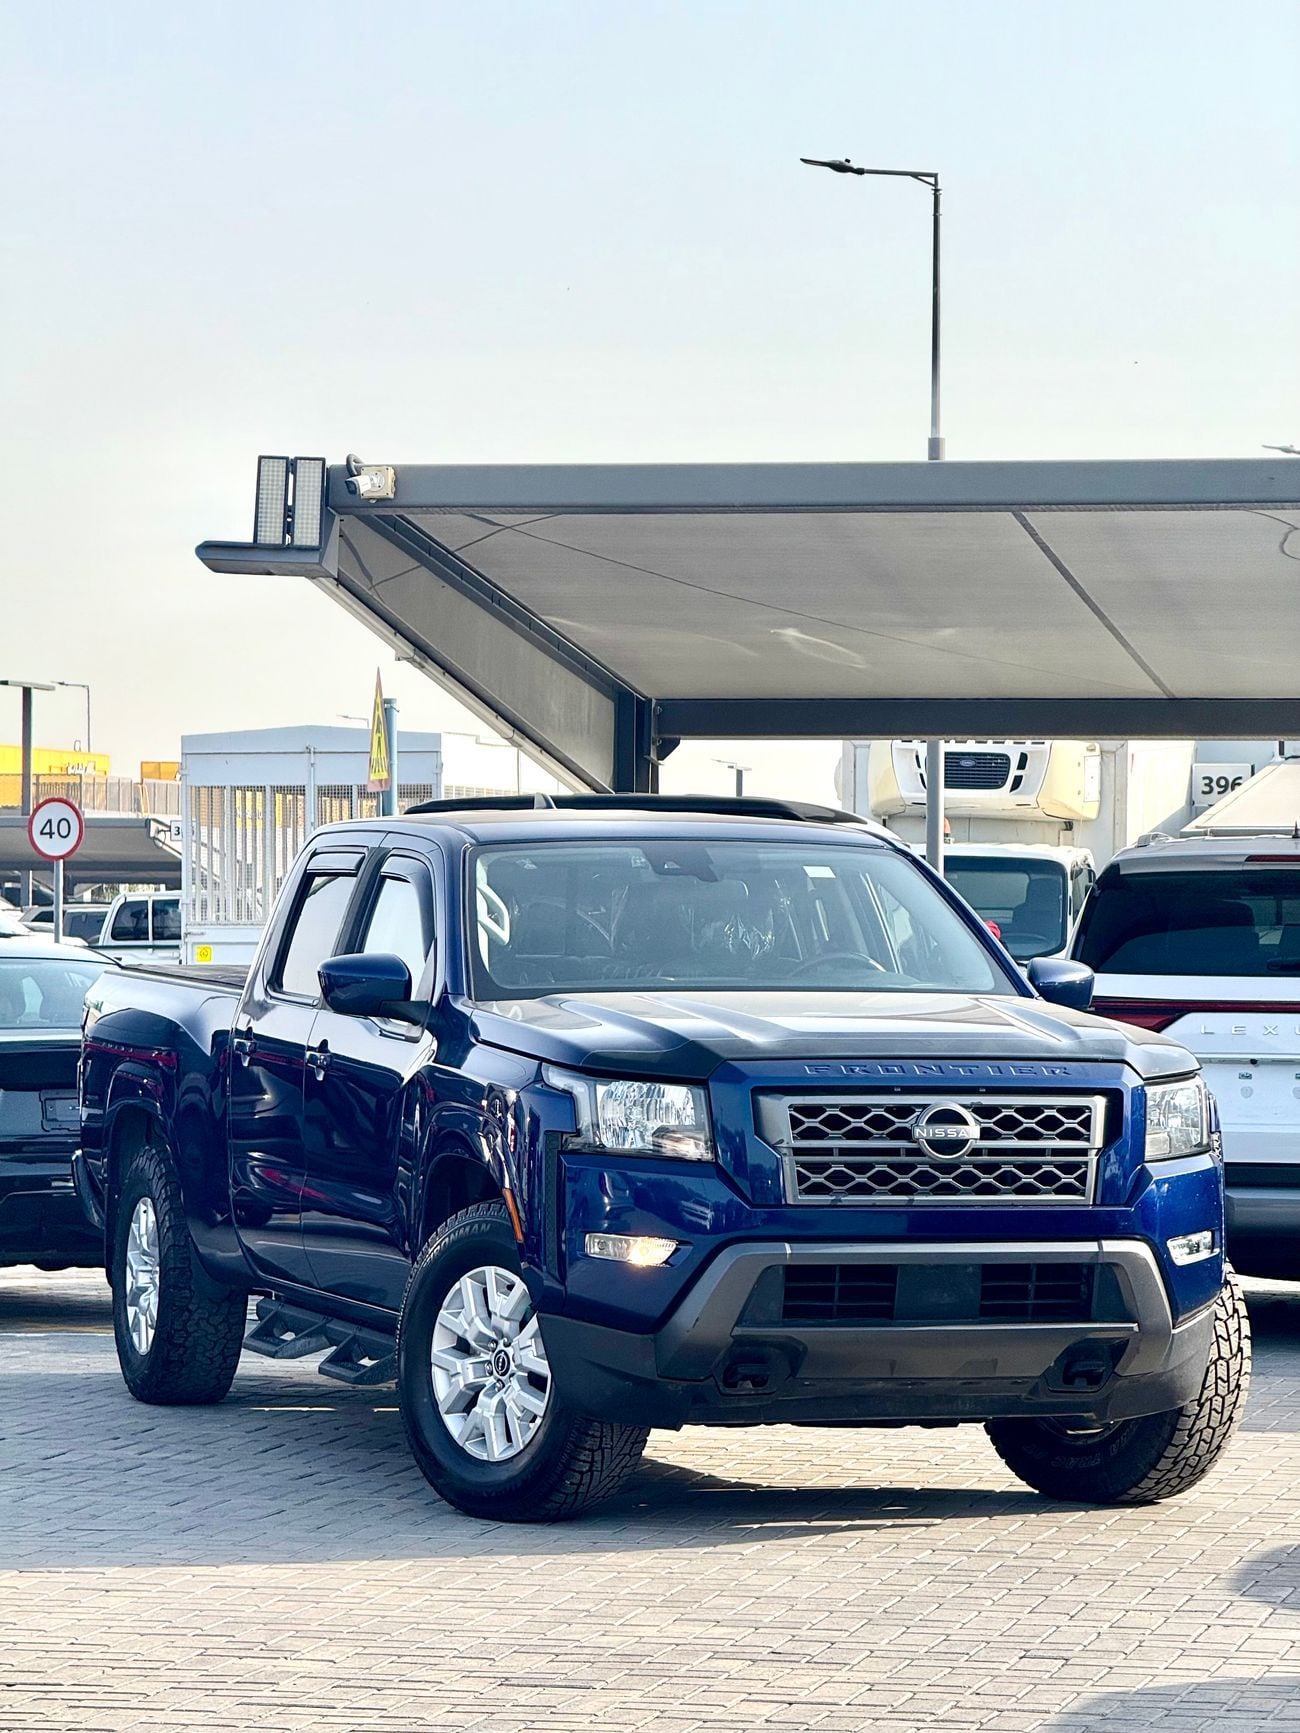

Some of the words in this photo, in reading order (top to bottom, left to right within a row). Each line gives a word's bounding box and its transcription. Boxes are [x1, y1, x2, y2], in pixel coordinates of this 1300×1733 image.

[39, 818, 72, 840] 40
[804, 1064, 1072, 1077] FRONTIER
[915, 1128, 977, 1138] NISSA
